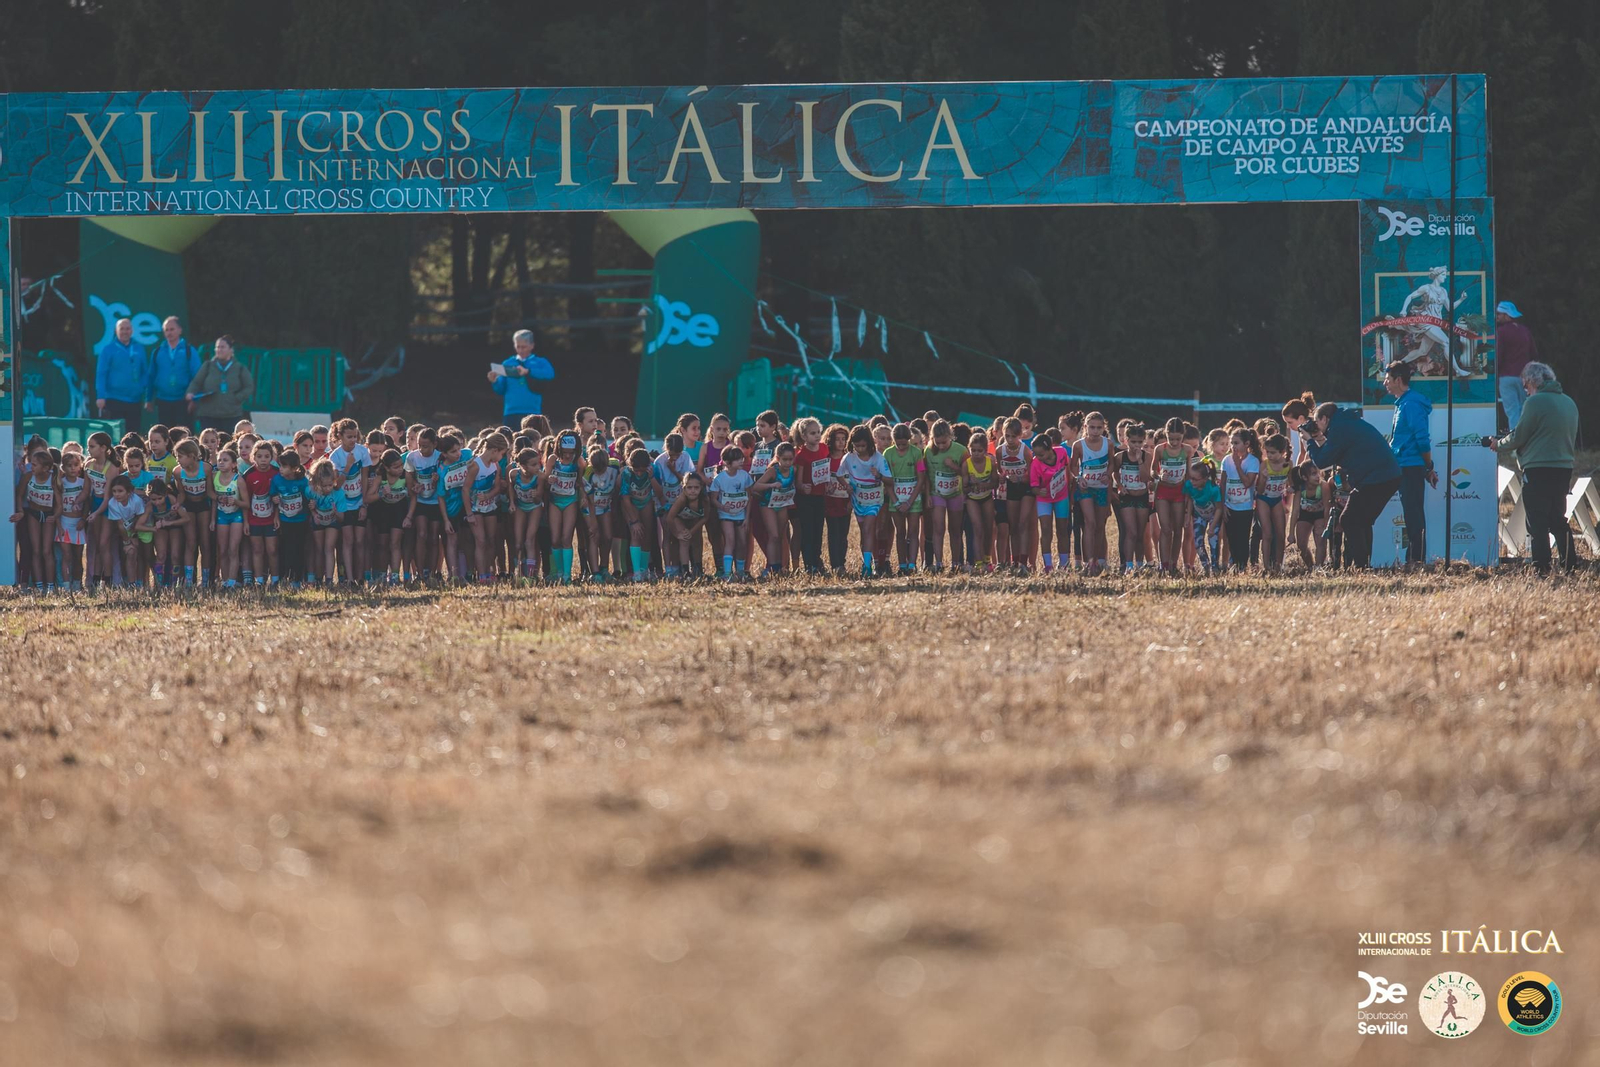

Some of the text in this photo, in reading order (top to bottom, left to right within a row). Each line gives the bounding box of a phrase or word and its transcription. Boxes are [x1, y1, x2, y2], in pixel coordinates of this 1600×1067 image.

[297, 109, 472, 152] CROSS
[553, 85, 984, 186] ITÁLICA
[1134, 113, 1452, 138] CAMPEONATO DE ANDALUCÍA
[66, 110, 290, 184] XLIII
[1185, 133, 1404, 156] DE CAMPO A TRAVÉS
[298, 156, 537, 181] INTERNACIONAL
[1234, 156, 1360, 175] POR CLUBES
[65, 187, 495, 212] INTERNATIONAL CROSS COUNTRY
[858, 490, 881, 500] 4382
